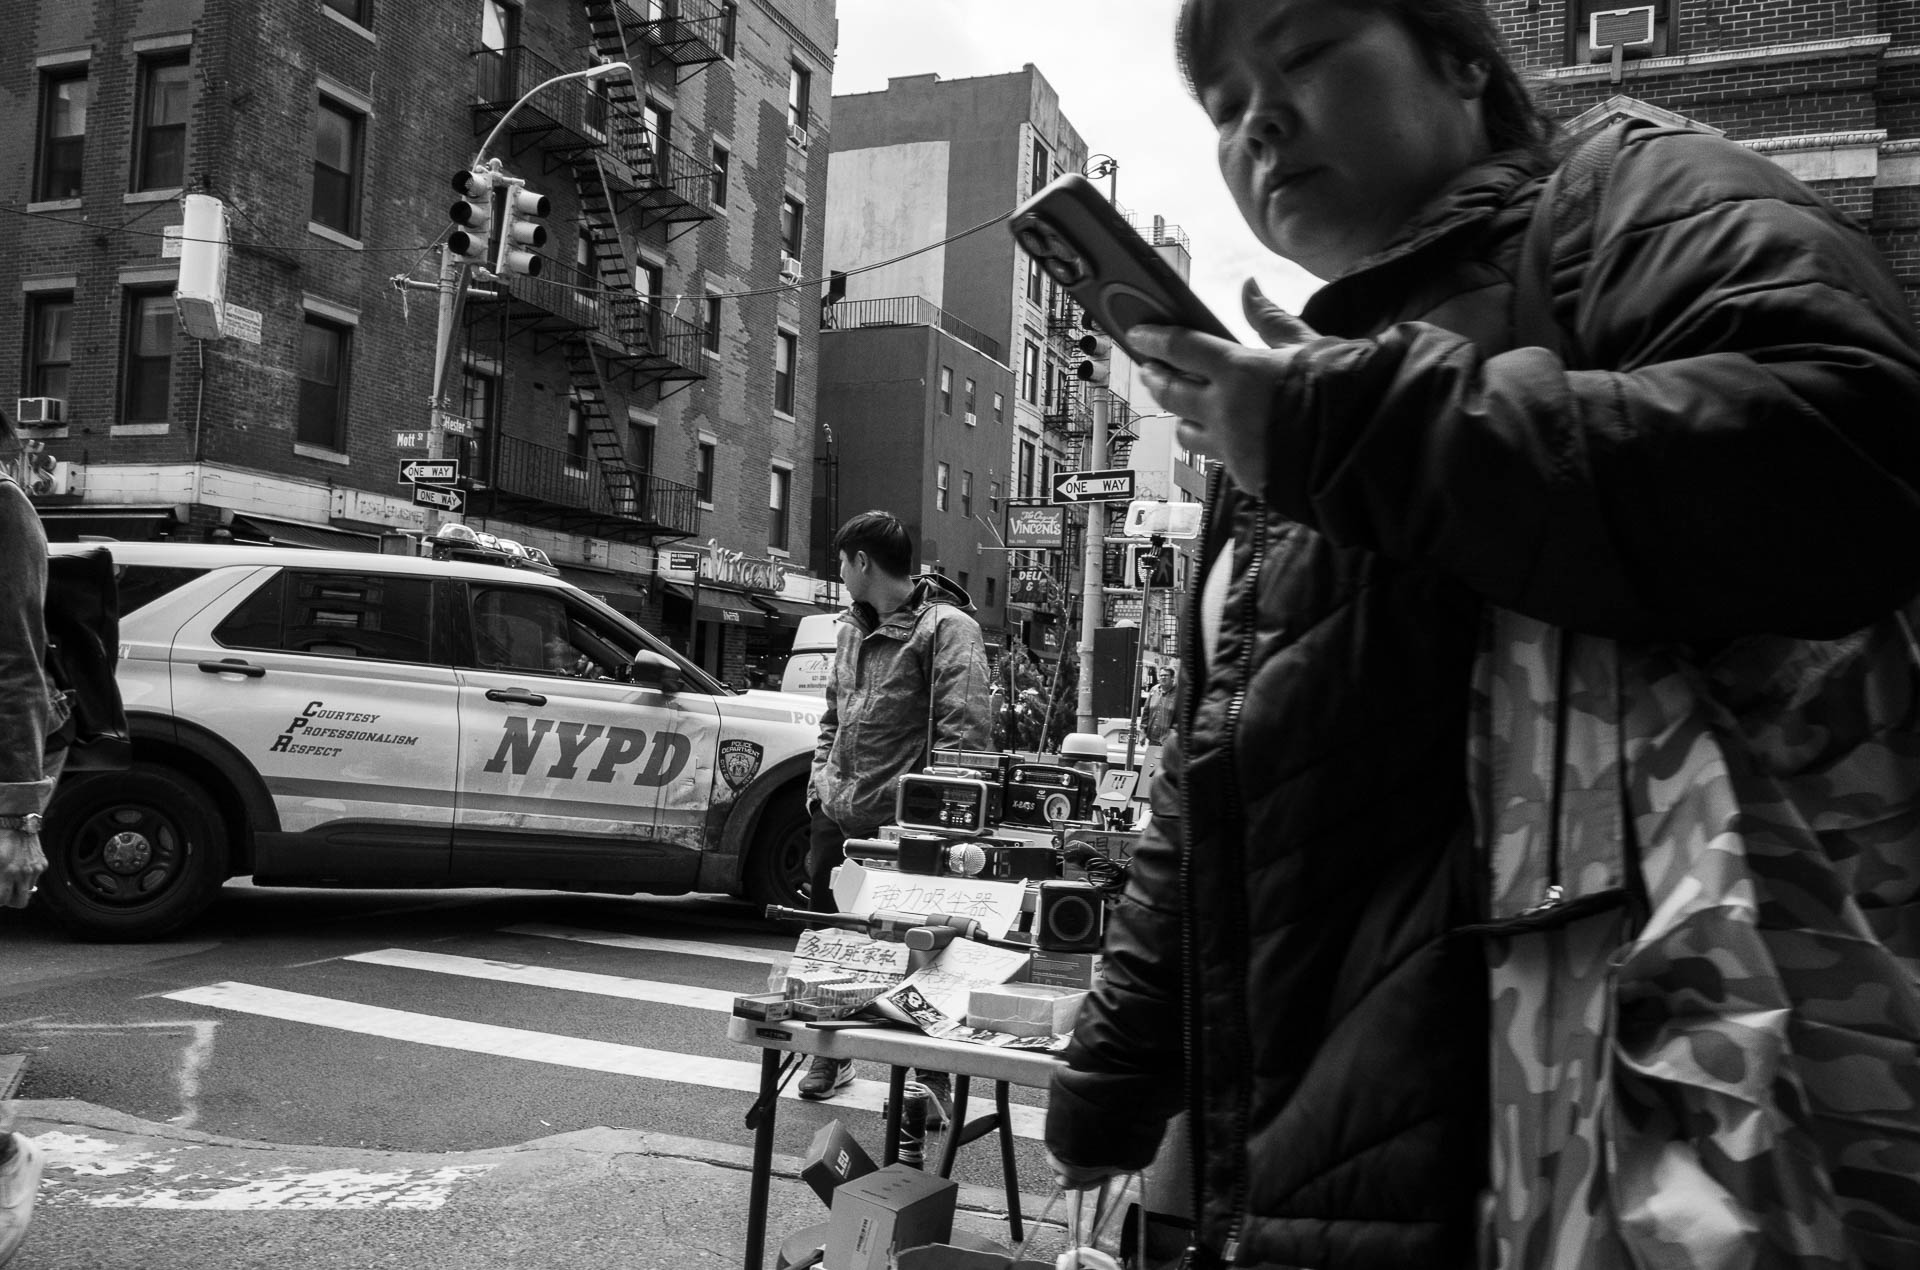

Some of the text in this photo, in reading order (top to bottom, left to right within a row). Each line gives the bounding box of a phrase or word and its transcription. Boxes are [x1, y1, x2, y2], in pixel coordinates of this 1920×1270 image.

[444, 416, 466, 433] Hester
[396, 433, 415, 447] Mott
[408, 467, 450, 477] ONE WAY
[1065, 480, 1126, 494] ONE WAY
[420, 491, 457, 506] ONE WAY
[1018, 571, 1042, 581] DELI
[1025, 581, 1034, 592] &
[302, 701, 381, 724] COURTESY
[285, 717, 419, 746] PROFESSIONALISM
[270, 735, 342, 758] RESPECT
[731, 740, 753, 749] POLICE
[483, 716, 691, 788] NYPD
[721, 746, 760, 759] DEPARTMENT
[1012, 800, 1036, 810] X-BASS
[803, 935, 897, 966] 多功能家私
[835, 1149, 850, 1176] LED
